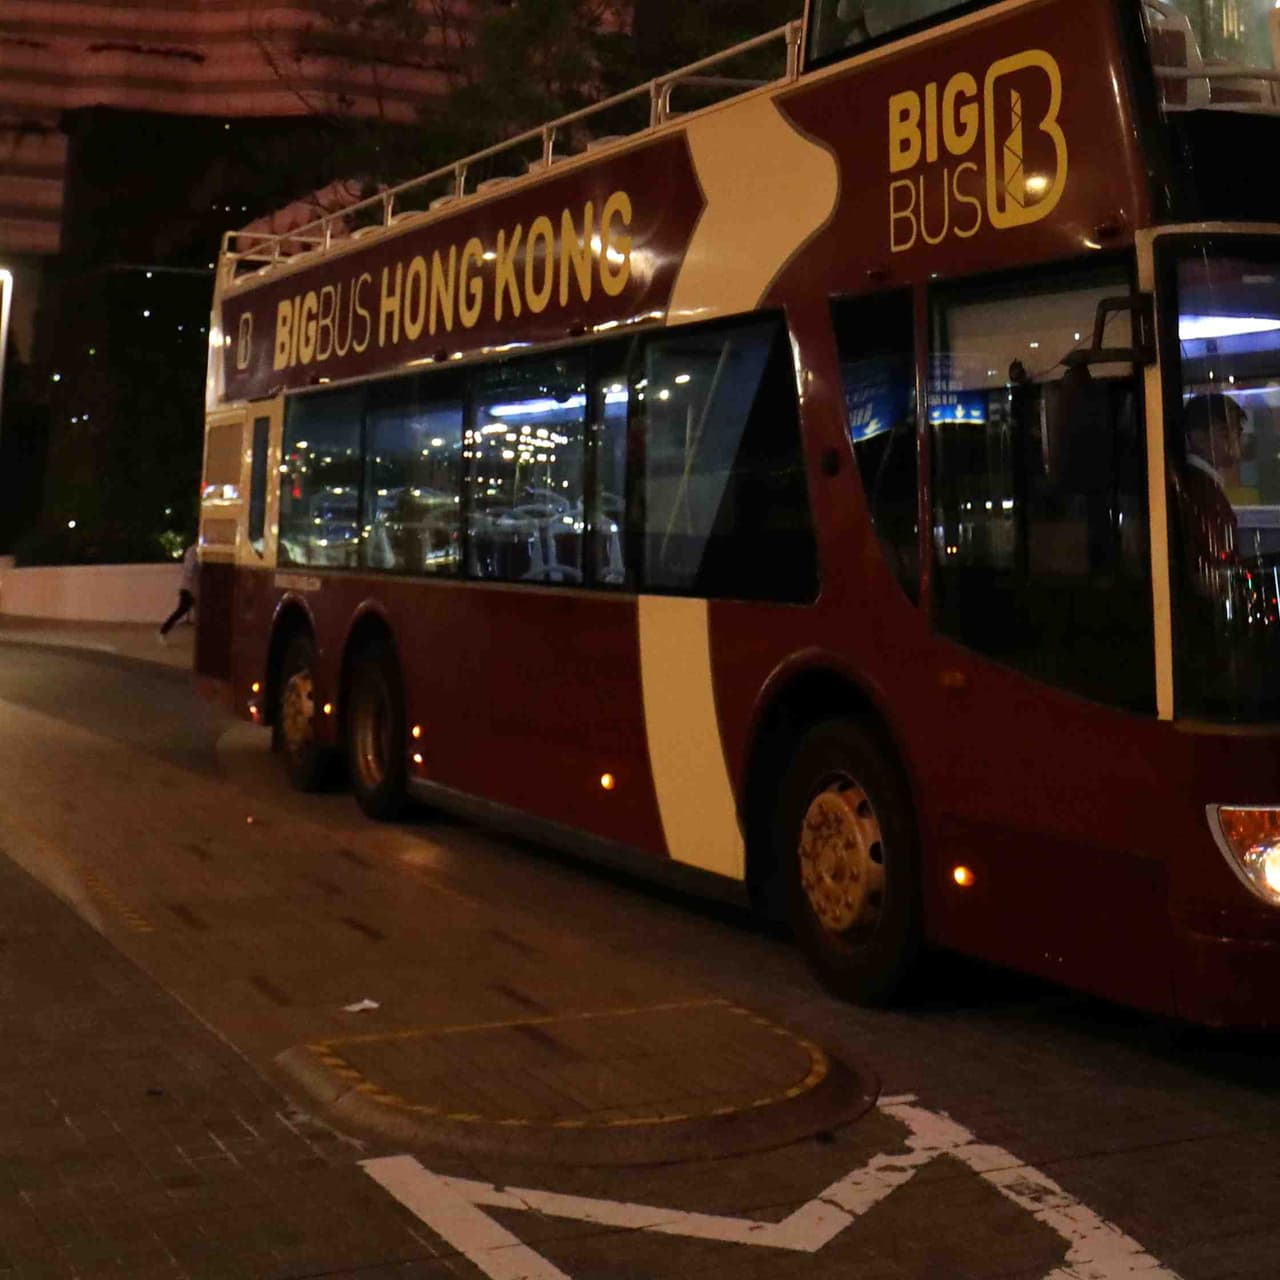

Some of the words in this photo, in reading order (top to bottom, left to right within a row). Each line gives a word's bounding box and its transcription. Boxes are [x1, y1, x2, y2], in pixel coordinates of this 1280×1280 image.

[889, 71, 980, 173] BIG
[889, 161, 982, 254] BUS
[377, 237, 483, 346] HONG
[494, 190, 634, 322] KONG
